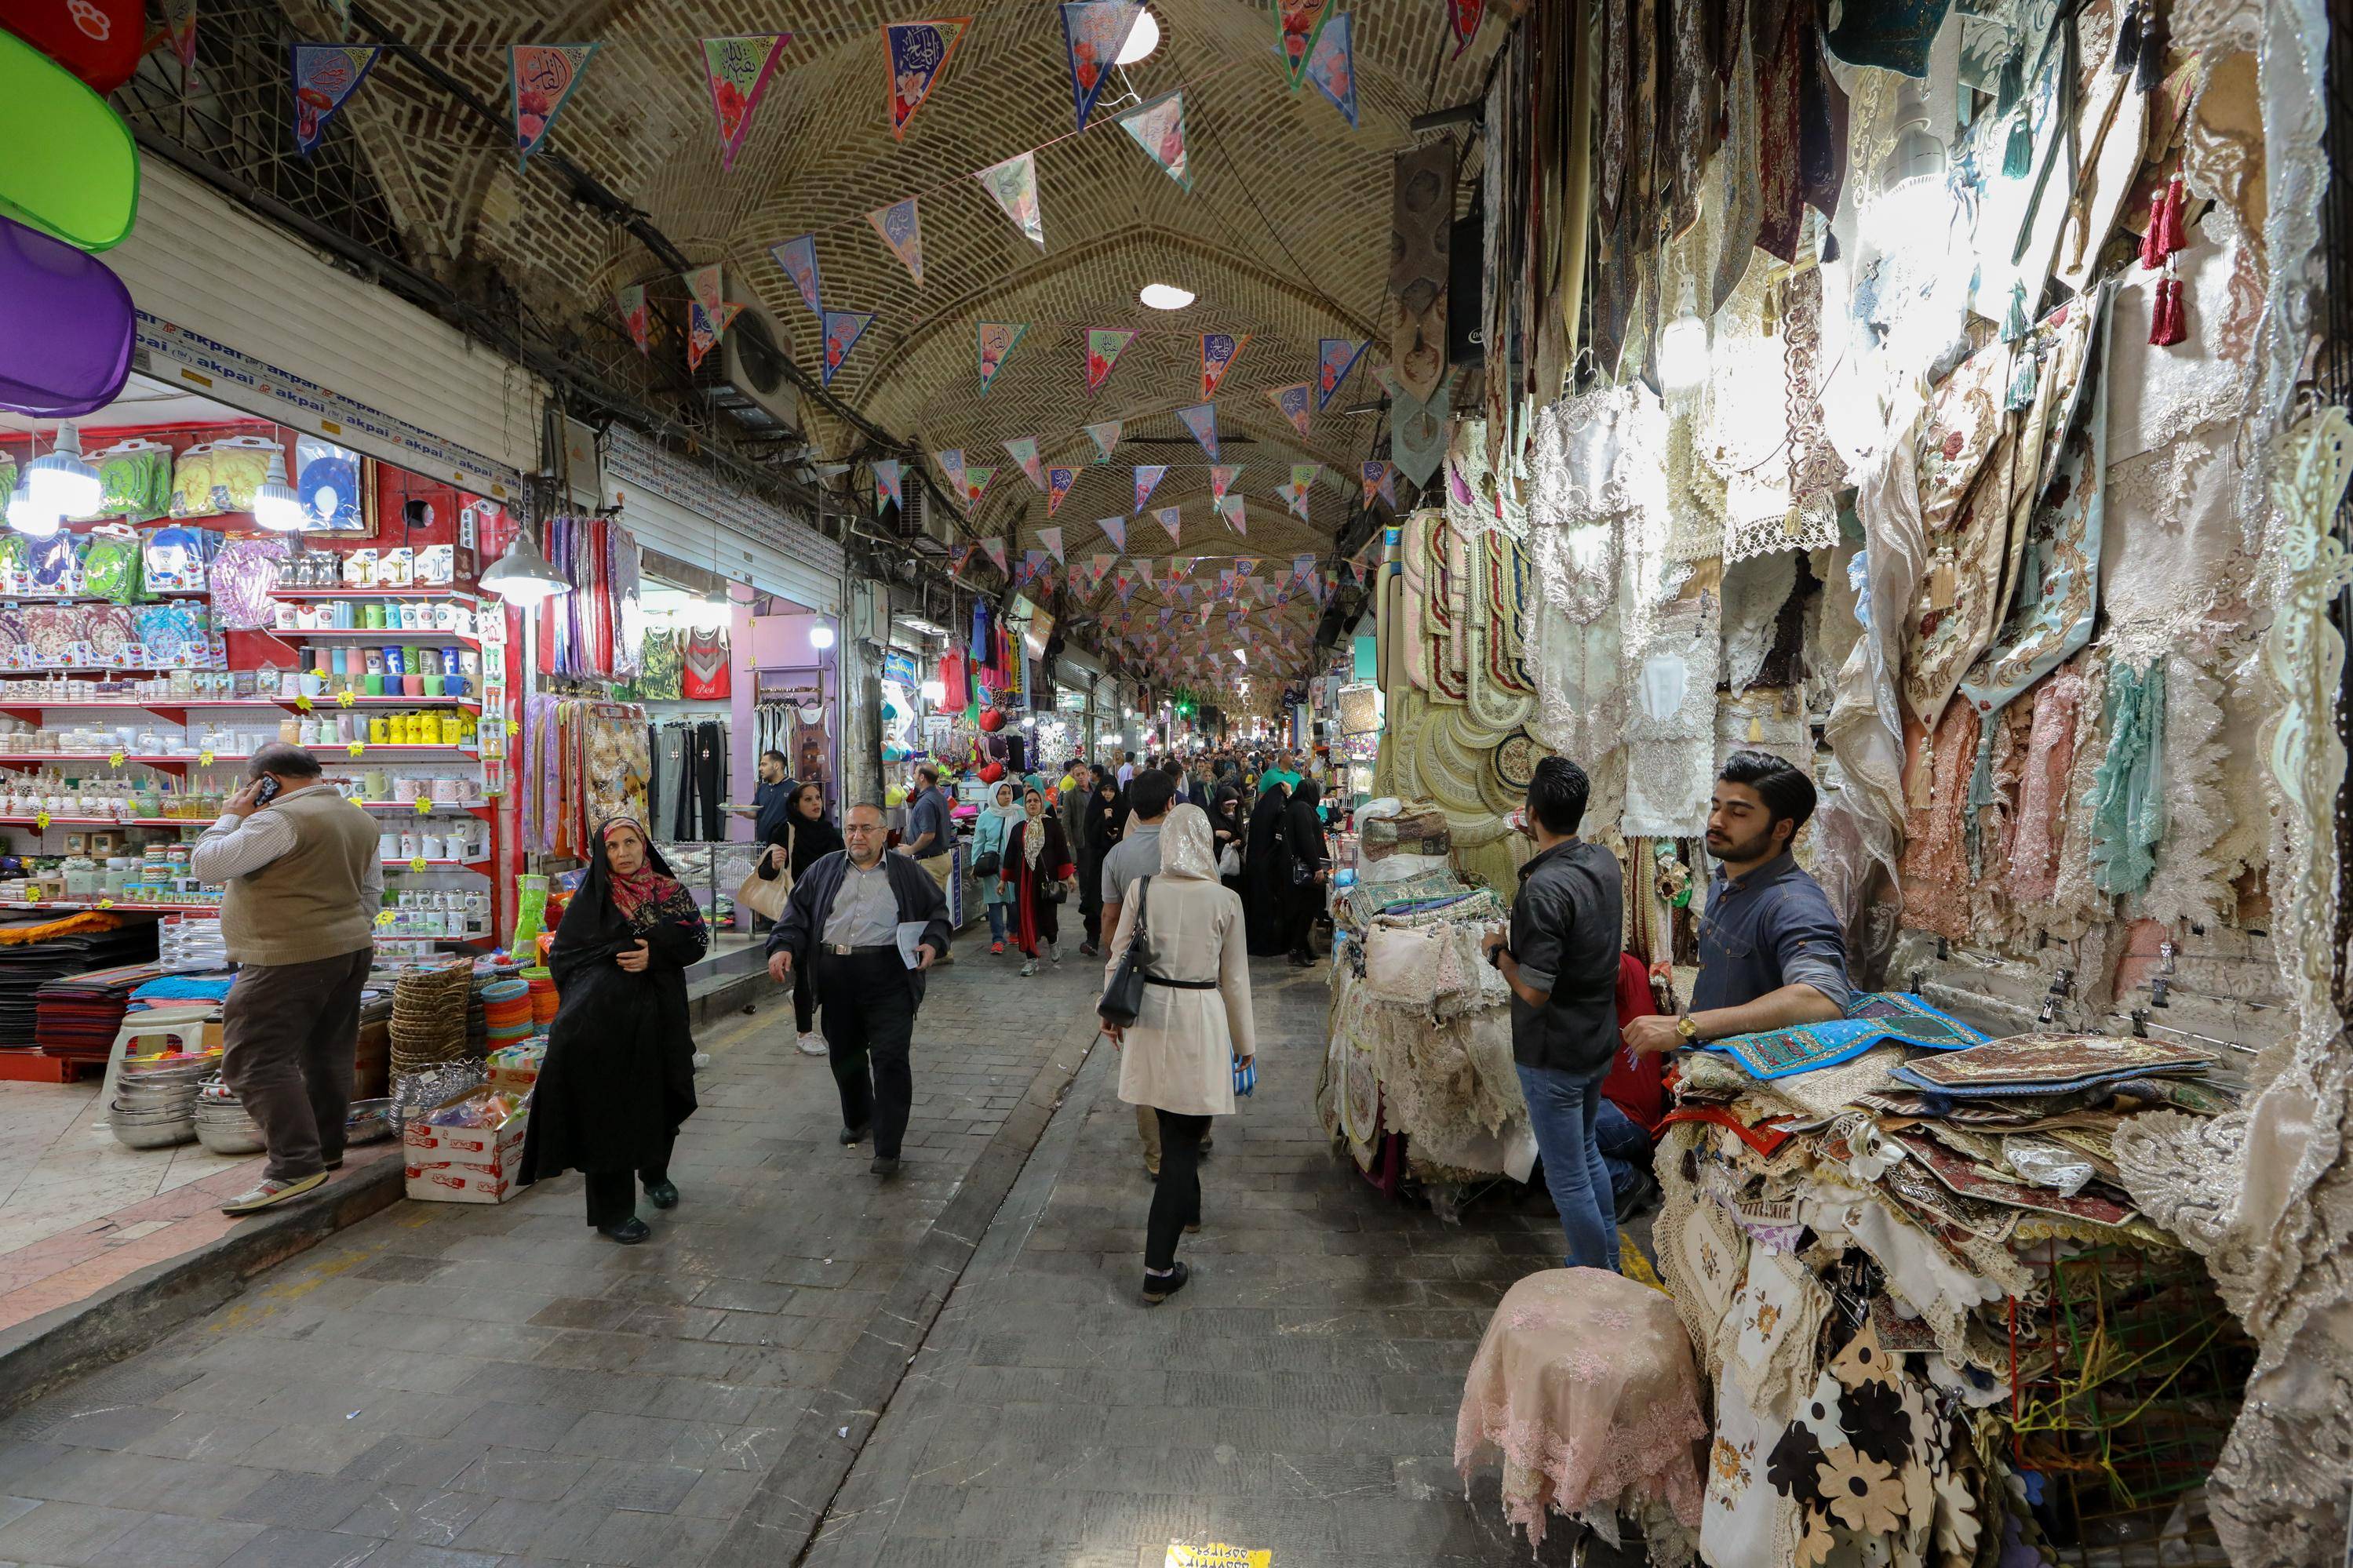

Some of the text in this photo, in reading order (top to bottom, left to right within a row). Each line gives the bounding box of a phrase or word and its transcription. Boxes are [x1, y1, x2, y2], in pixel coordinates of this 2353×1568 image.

[197, 356, 254, 385] akpai
[275, 387, 325, 413] akpai
[346, 415, 389, 438] akpai
[405, 438, 443, 459] akpai
[458, 459, 493, 478] akpai
[695, 683, 716, 694] Red
[450, 1140, 478, 1150] EDALAT
[431, 1173, 460, 1186] EDALAT
